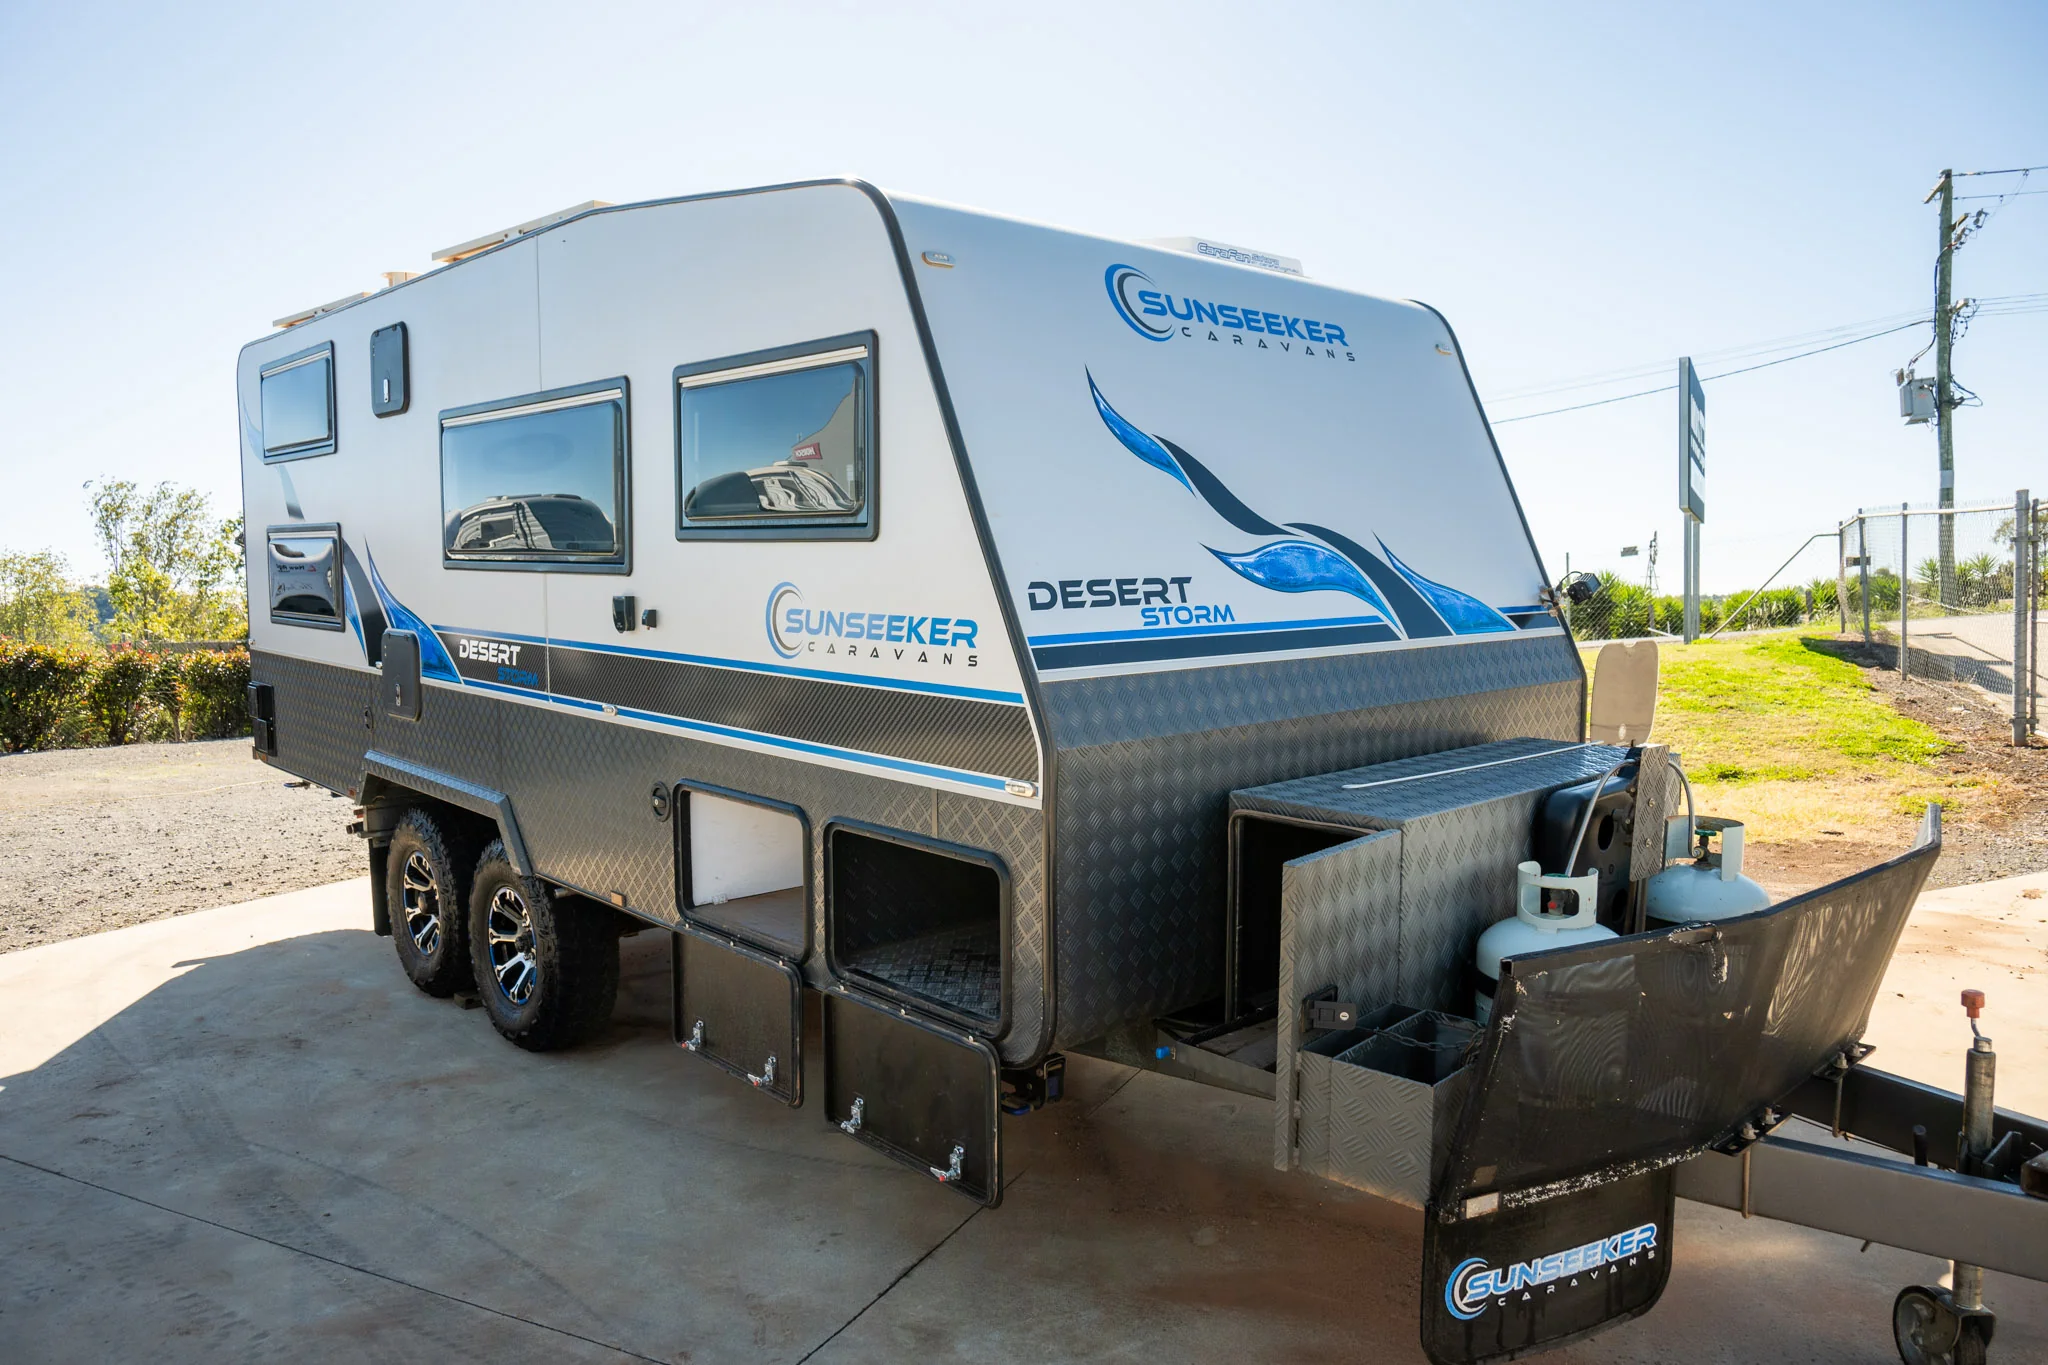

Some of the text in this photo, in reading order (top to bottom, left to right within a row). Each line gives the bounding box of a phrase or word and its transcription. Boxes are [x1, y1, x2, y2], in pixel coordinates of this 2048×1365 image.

[1197, 242, 1251, 264] CaraFan
[1138, 289, 1350, 347] SUNSEEKER
[1181, 326, 1356, 362] CARAVANS
[1027, 576, 1193, 611] DESERT
[784, 608, 979, 649] SUNSEEKER
[1140, 604, 1236, 627] STORM
[458, 638, 521, 667] DESERT
[807, 641, 978, 668] CARAVANS
[497, 665, 539, 687] STORM
[1464, 1222, 1658, 1303] SUNSEEKER
[1498, 1251, 1656, 1307] CARAVANS
